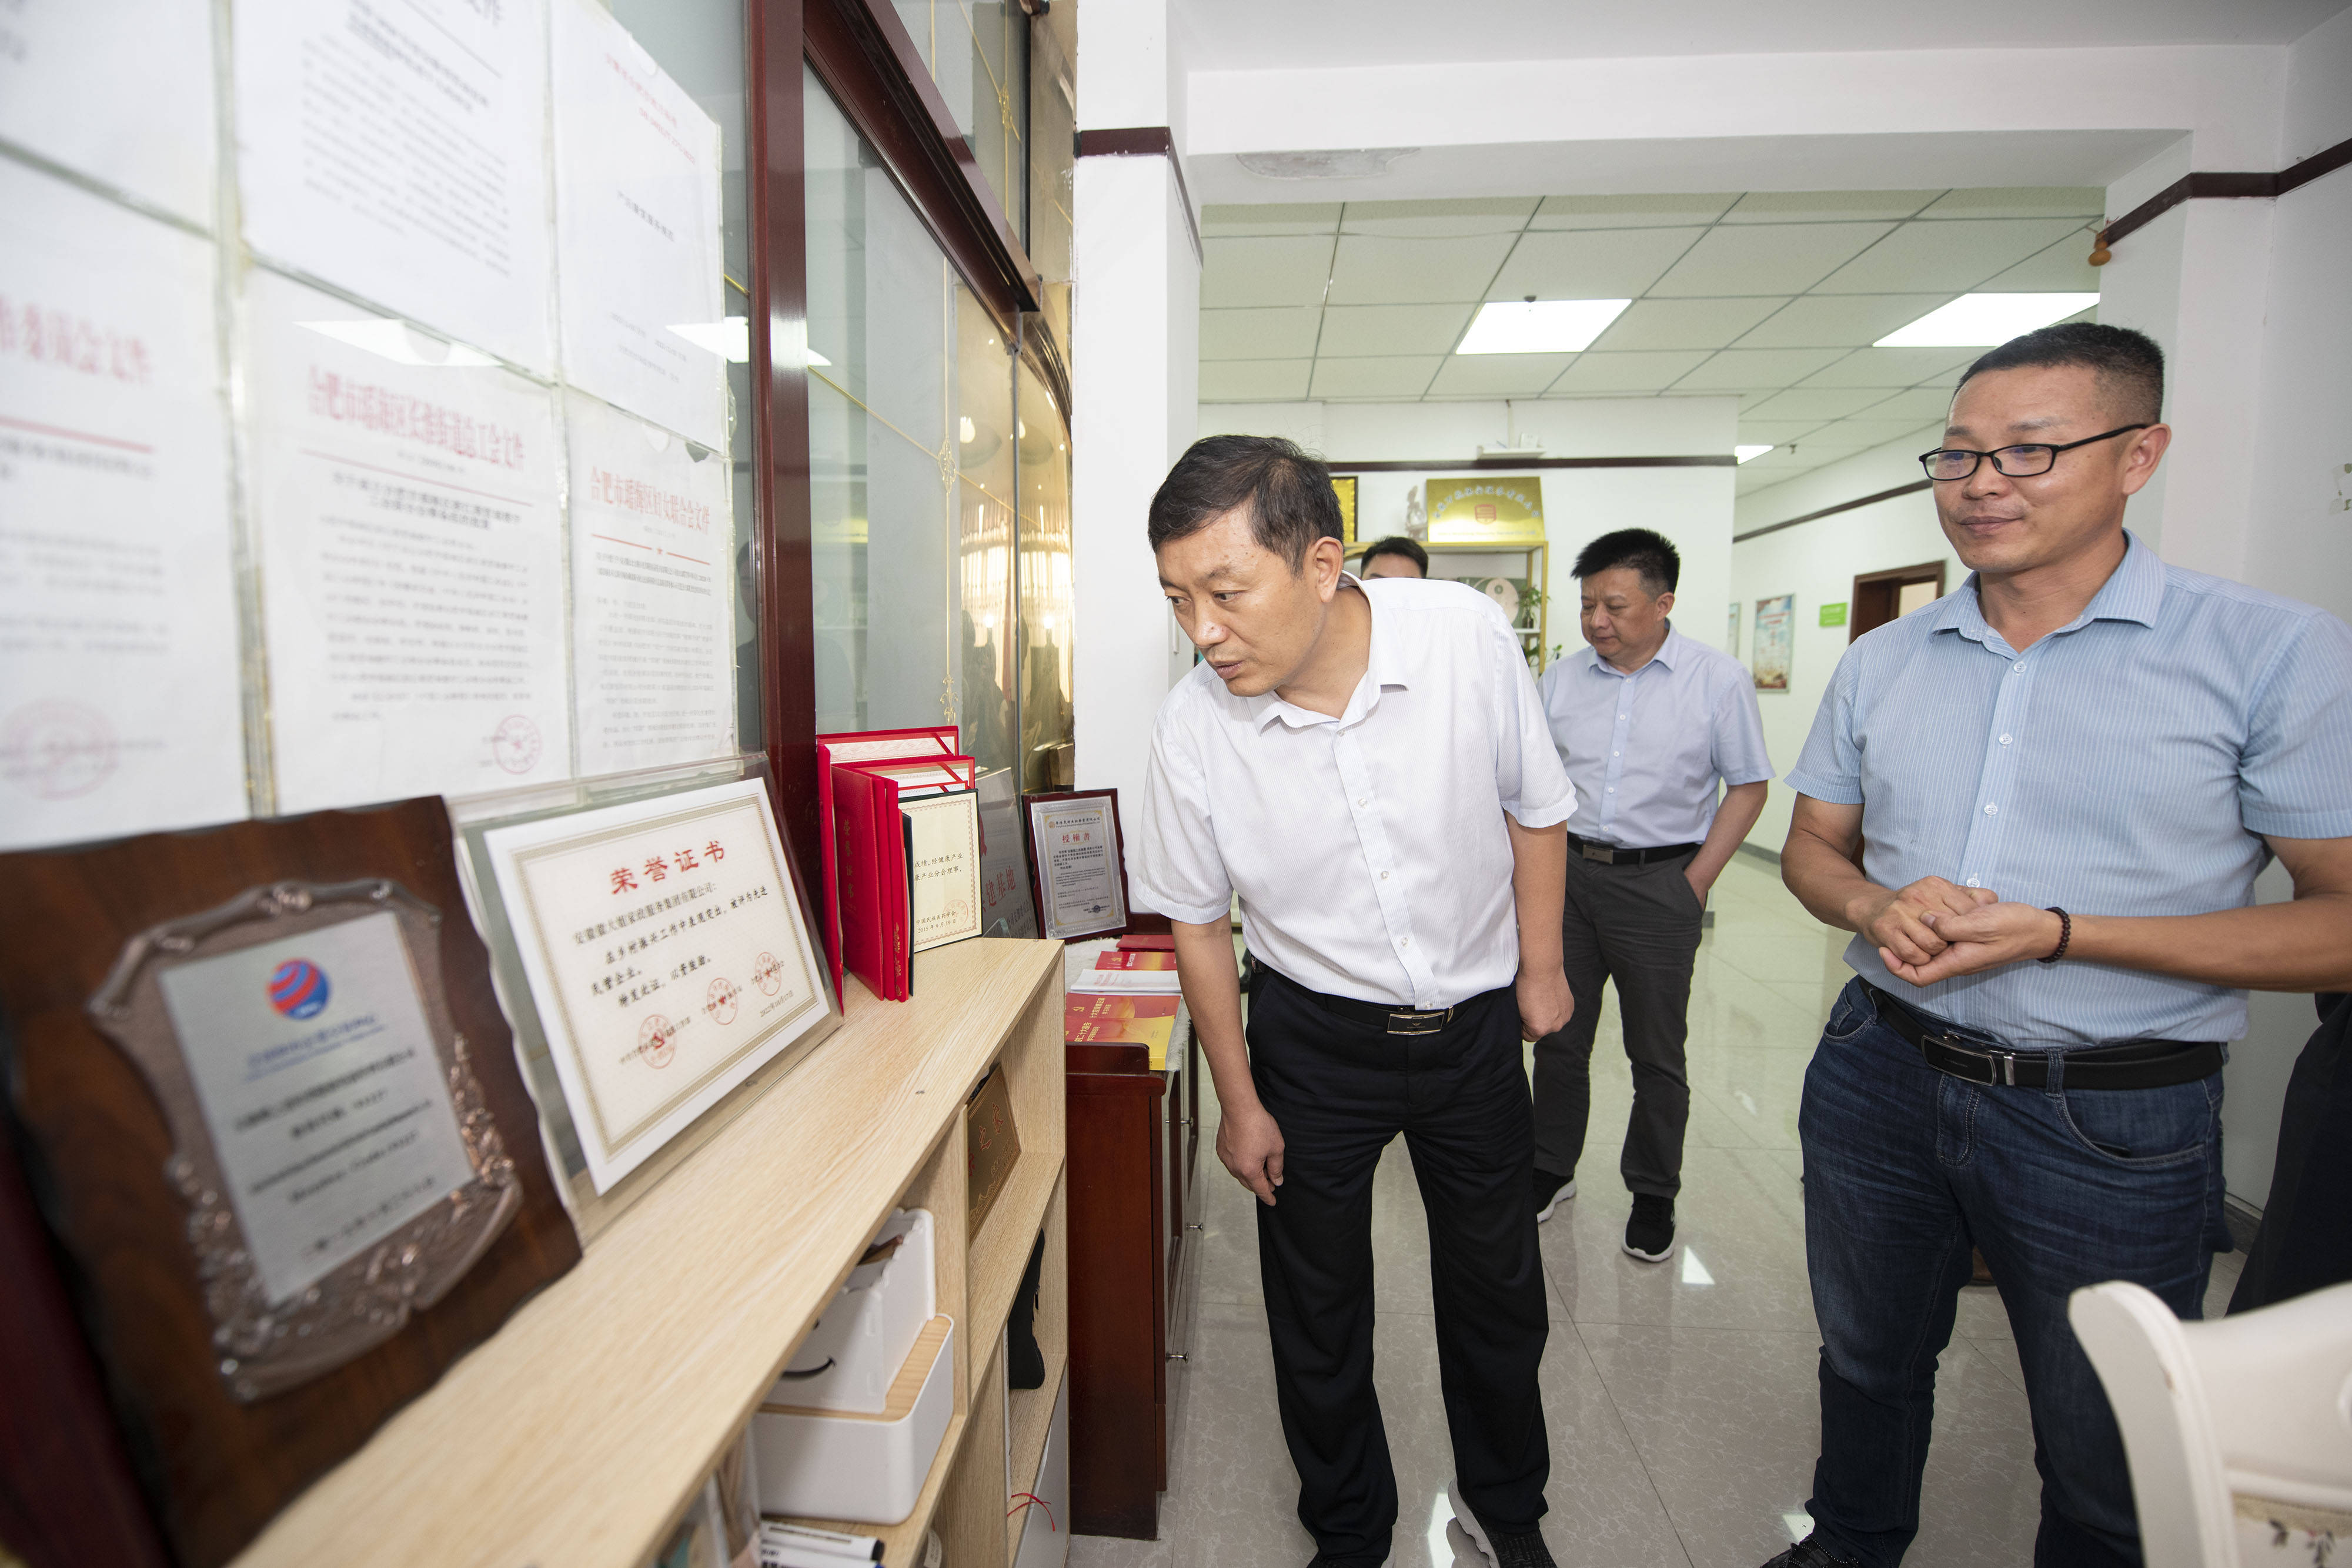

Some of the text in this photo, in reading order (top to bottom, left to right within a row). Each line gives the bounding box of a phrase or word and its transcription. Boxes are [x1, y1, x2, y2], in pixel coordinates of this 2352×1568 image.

[610, 840, 725, 894] 荣誉证书
[916, 911, 957, 924] 中国民族医药学会
